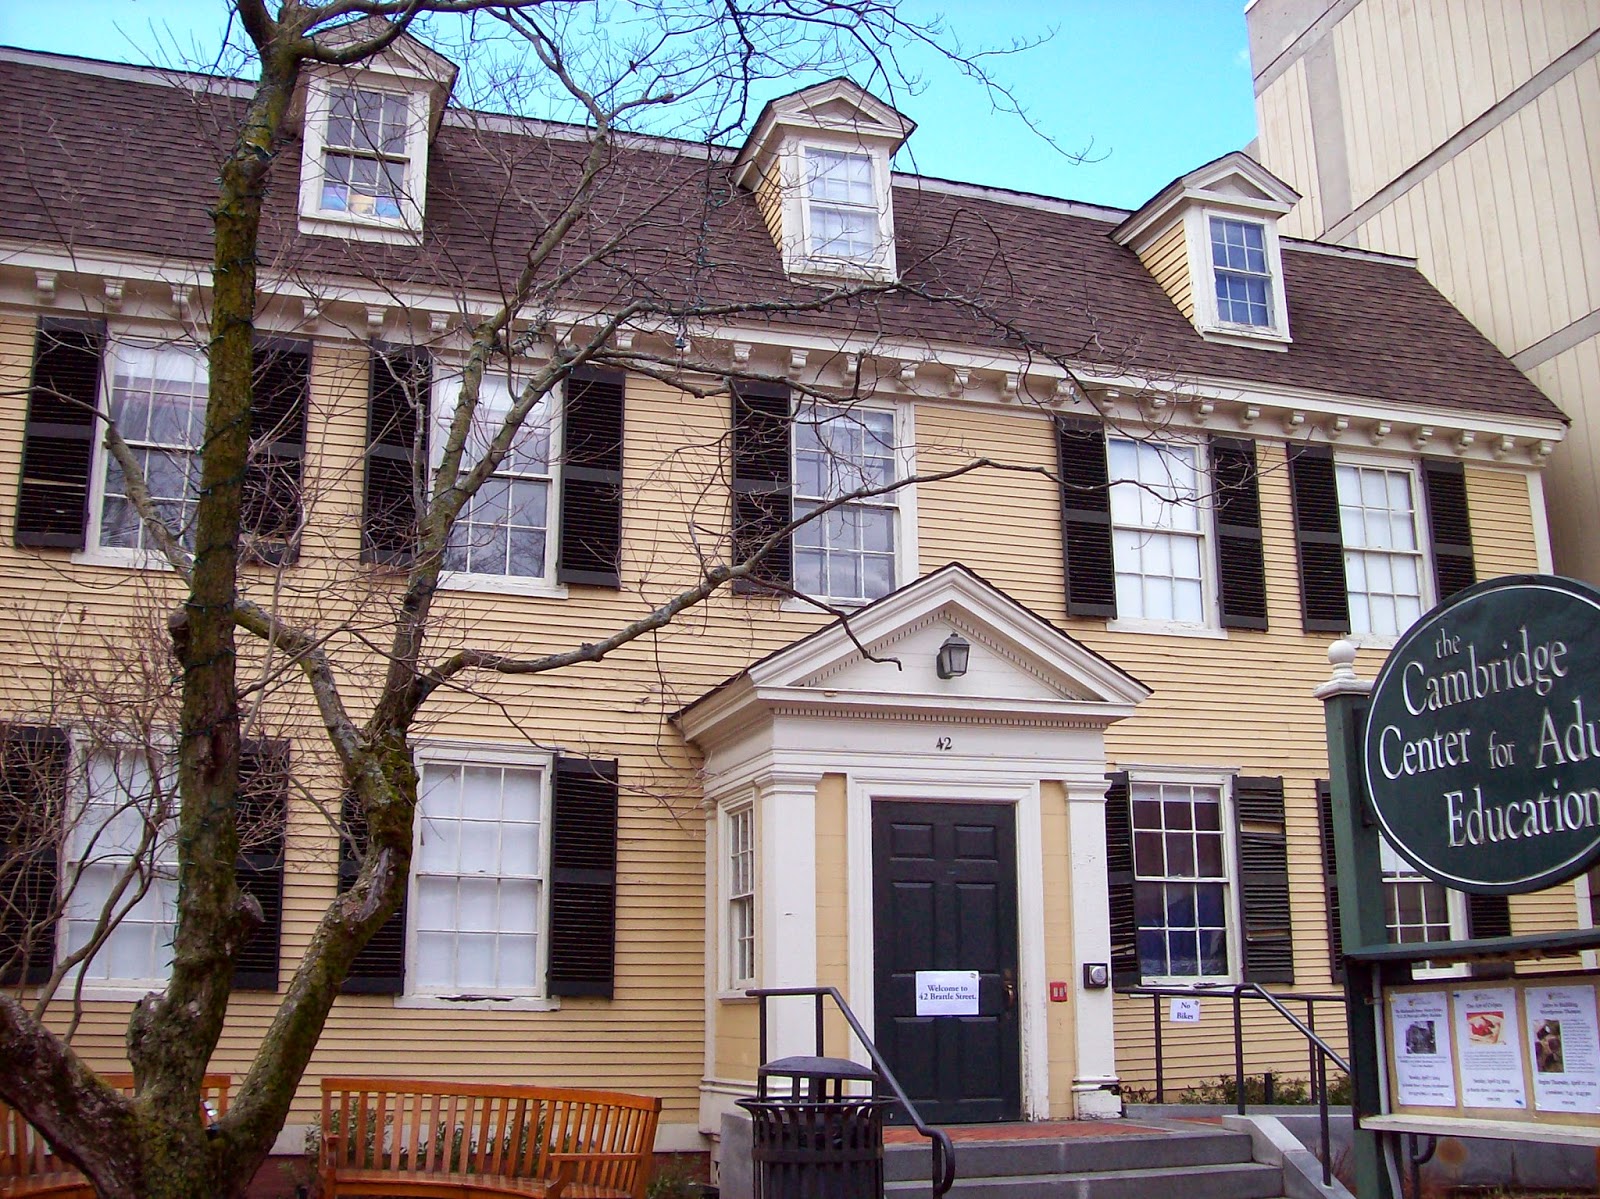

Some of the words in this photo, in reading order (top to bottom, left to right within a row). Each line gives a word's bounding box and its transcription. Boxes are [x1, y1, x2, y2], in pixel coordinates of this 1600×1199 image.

[1436, 628, 1461, 659] the
[1402, 625, 1568, 716] Cambridge
[936, 736, 953, 751] 42
[1379, 724, 1471, 780] Center
[1488, 730, 1516, 769] for
[1443, 778, 1600, 848] Education
[927, 984, 959, 992] Welcome
[1176, 1012, 1194, 1020] Bikes
